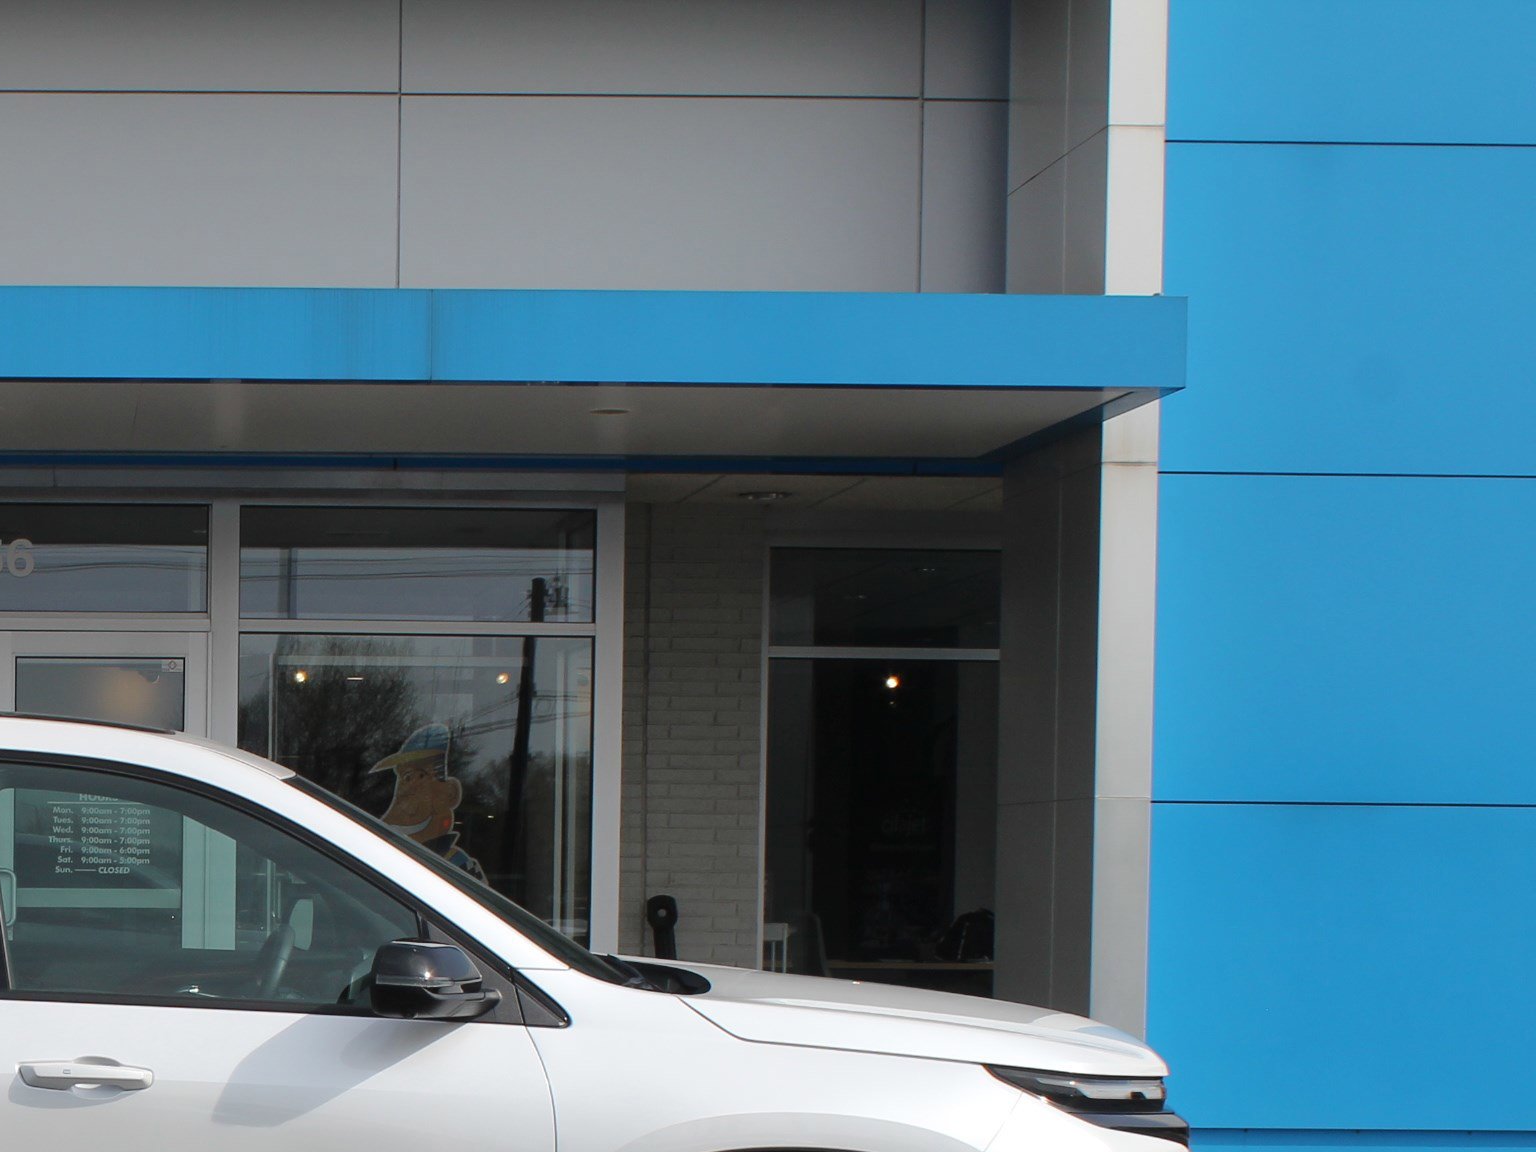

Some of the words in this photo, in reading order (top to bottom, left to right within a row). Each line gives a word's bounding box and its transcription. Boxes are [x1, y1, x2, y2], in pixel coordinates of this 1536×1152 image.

[79, 793, 119, 802] HOU
[52, 806, 74, 814] Mon.
[53, 816, 74, 824] Tues.
[52, 826, 74, 834] Wed.
[55, 865, 73, 873] Sun.
[98, 866, 131, 874] CLOSED
